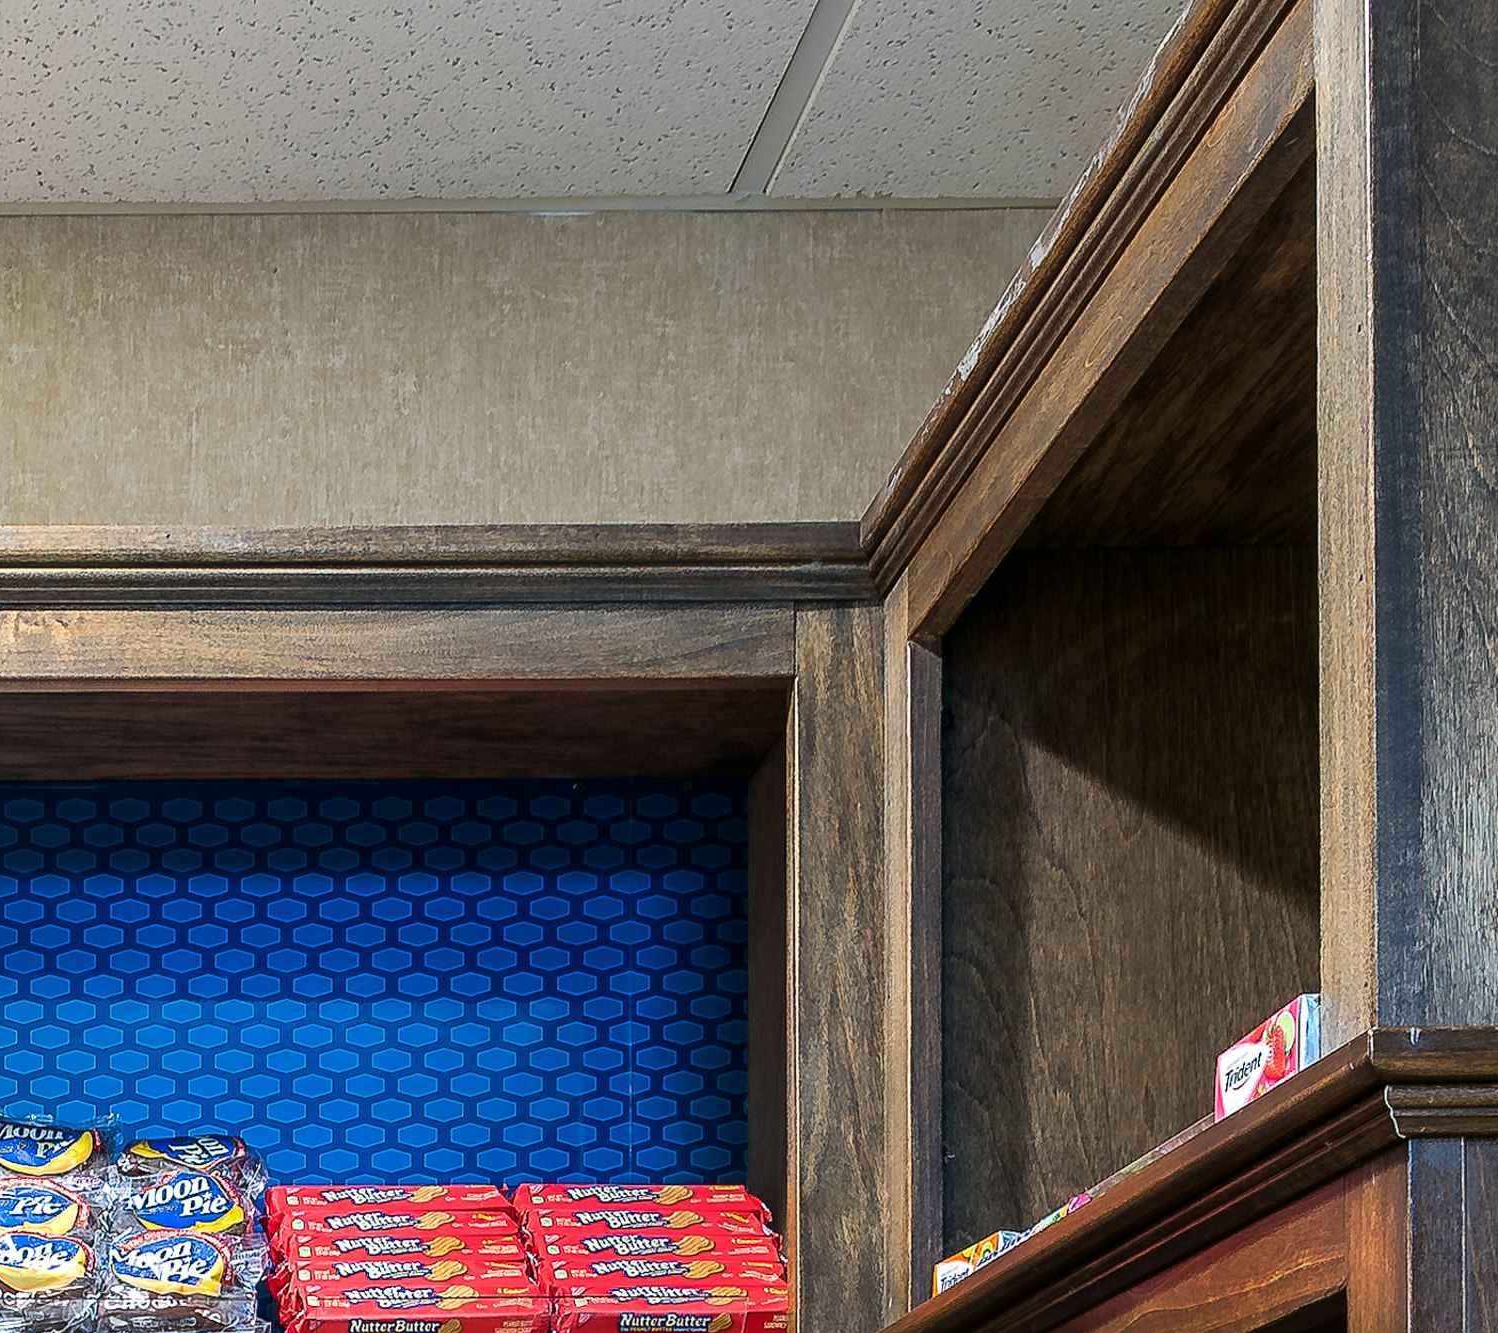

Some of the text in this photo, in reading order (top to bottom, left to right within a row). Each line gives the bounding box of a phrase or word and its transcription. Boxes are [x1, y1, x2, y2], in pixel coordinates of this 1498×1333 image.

[1224, 1051, 1262, 1093] Trident
[127, 1176, 210, 1210] Moon
[181, 1197, 227, 1217] Pie
[576, 1211, 659, 1228] Nutter Butter
[584, 1235, 669, 1255] Nutter Butter
[110, 1242, 192, 1273] Moon
[161, 1259, 209, 1281] Pie
[350, 1319, 440, 1332] Nutter Butter
[621, 1313, 710, 1327] Nutter Butter
